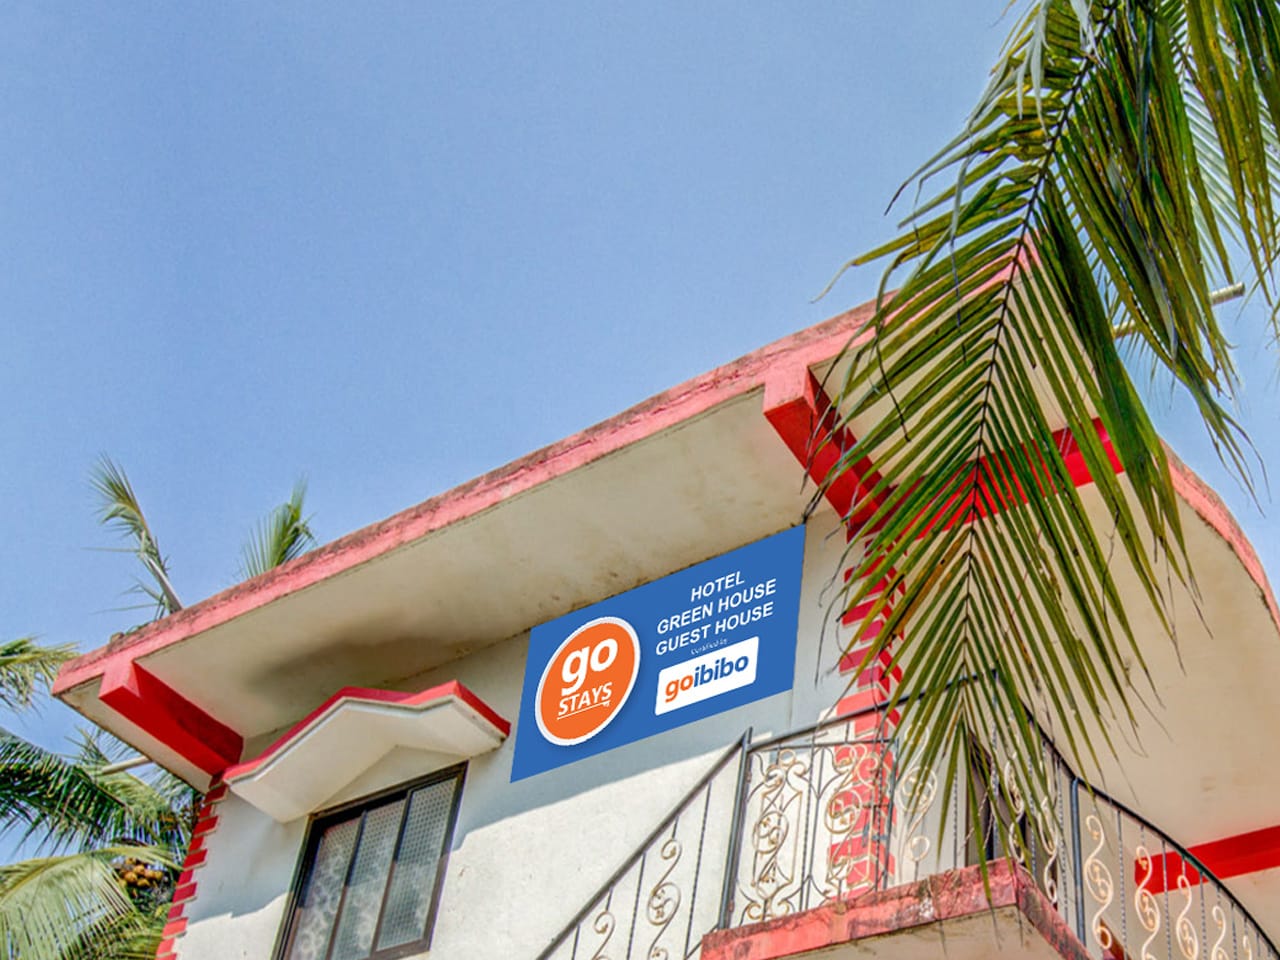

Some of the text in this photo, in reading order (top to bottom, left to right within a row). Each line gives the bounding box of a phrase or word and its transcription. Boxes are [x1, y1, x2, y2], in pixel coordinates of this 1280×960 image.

[657, 578, 777, 634] GREEN HOUSE
[691, 571, 745, 602] HOTEL
[656, 601, 774, 655] GUEST HOUSE
[561, 638, 618, 696] go
[664, 656, 750, 703] goibibo
[558, 681, 613, 716] STAYS
